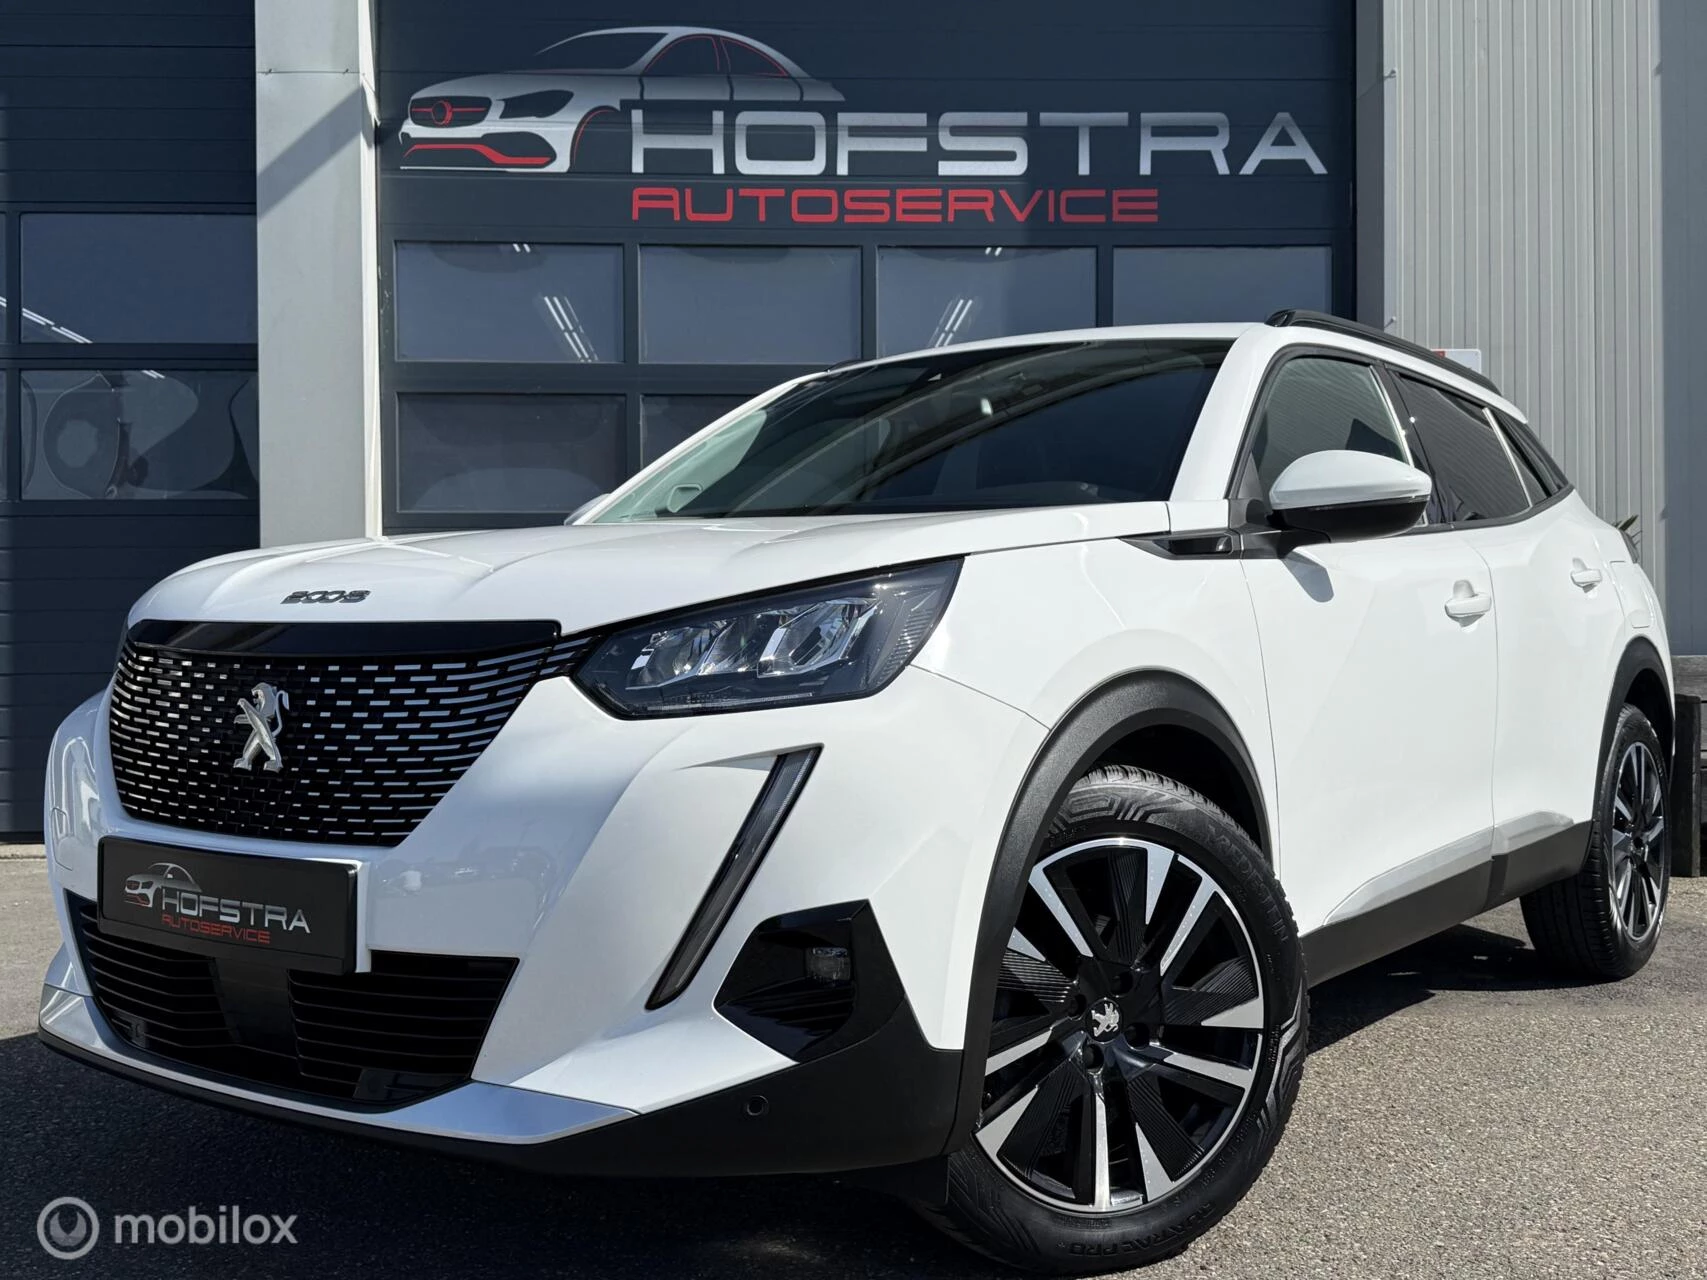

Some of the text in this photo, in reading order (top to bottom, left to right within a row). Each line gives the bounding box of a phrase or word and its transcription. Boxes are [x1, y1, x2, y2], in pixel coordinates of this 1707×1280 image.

[632, 111, 1328, 176] HOFSTRA
[632, 187, 1159, 223] AUTOSERVICE
[161, 914, 271, 945] AUTOSERVICE
[162, 888, 311, 934] HOFSTRA
